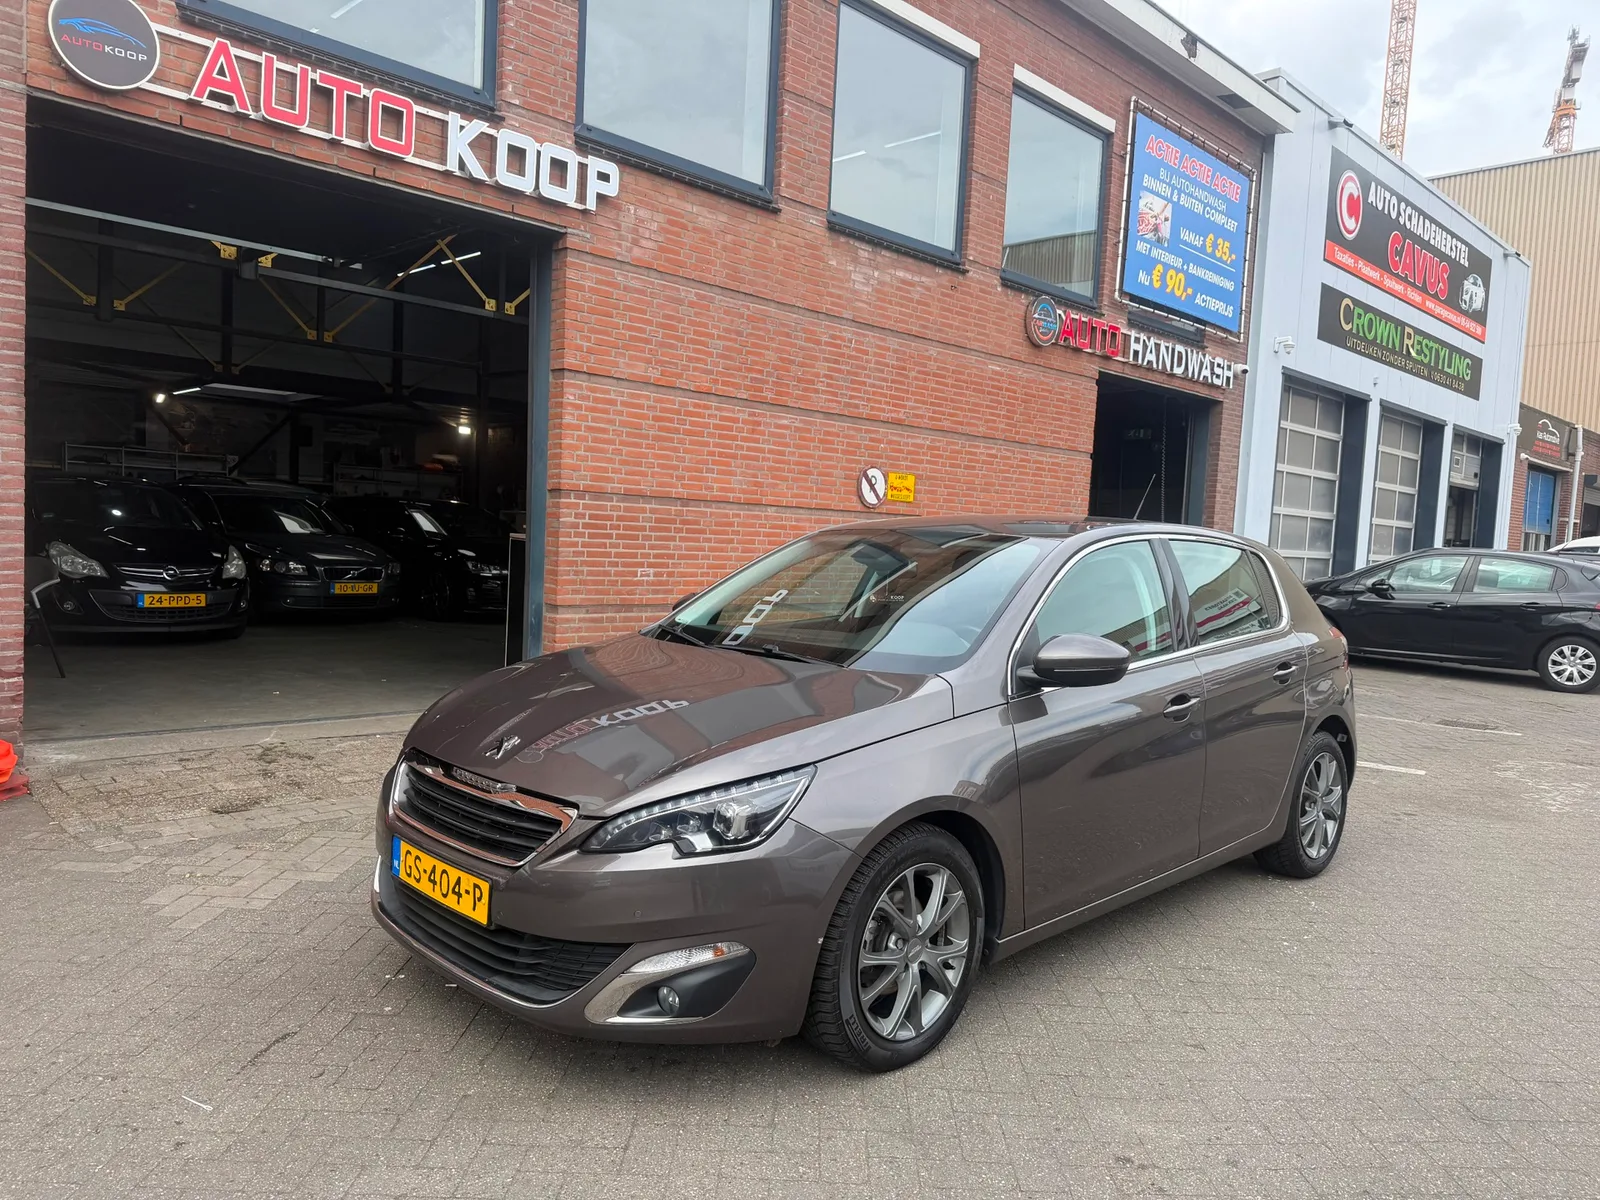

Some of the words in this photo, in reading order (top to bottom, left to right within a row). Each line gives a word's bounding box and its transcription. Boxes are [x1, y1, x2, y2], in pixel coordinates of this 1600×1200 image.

[61, 33, 148, 62] AUTOKOOP
[190, 37, 416, 159] AUTO
[446, 110, 620, 211] KOOP
[1145, 134, 1180, 169] ACTIE
[1180, 154, 1213, 187] ACTIE
[1211, 172, 1242, 203] ACTIE
[1160, 168, 1170, 183] BIJ
[1171, 174, 1227, 213] AUTOHANDWASH
[1142, 174, 1172, 199] BINNEN
[1172, 189, 1179, 202] &
[1179, 191, 1204, 216] BUITEN
[1204, 205, 1238, 233] COMPLEET
[1367, 181, 1398, 220] AUTO
[1399, 201, 1470, 268] SCHADEHERSTEL
[1135, 240, 1151, 255] MET
[1150, 245, 1183, 269] INTERIEUR
[1188, 262, 1235, 291] BANKREINIGING
[1180, 227, 1204, 248] VANAF
[1388, 230, 1450, 300] CAVUS
[1194, 292, 1234, 318] ACTIEPRIJS
[1058, 309, 1122, 357] AUTO
[1129, 329, 1236, 389] HANDWASH
[1339, 297, 1402, 352] CROWN
[1402, 325, 1472, 381] RESTYLING
[1346, 335, 1382, 360] UITDEUKEN
[1382, 350, 1405, 369] ZONDER
[1405, 360, 1428, 378] SPUITEN
[148, 595, 203, 606] 24-PPD-5
[404, 849, 483, 912] GS-404-P
